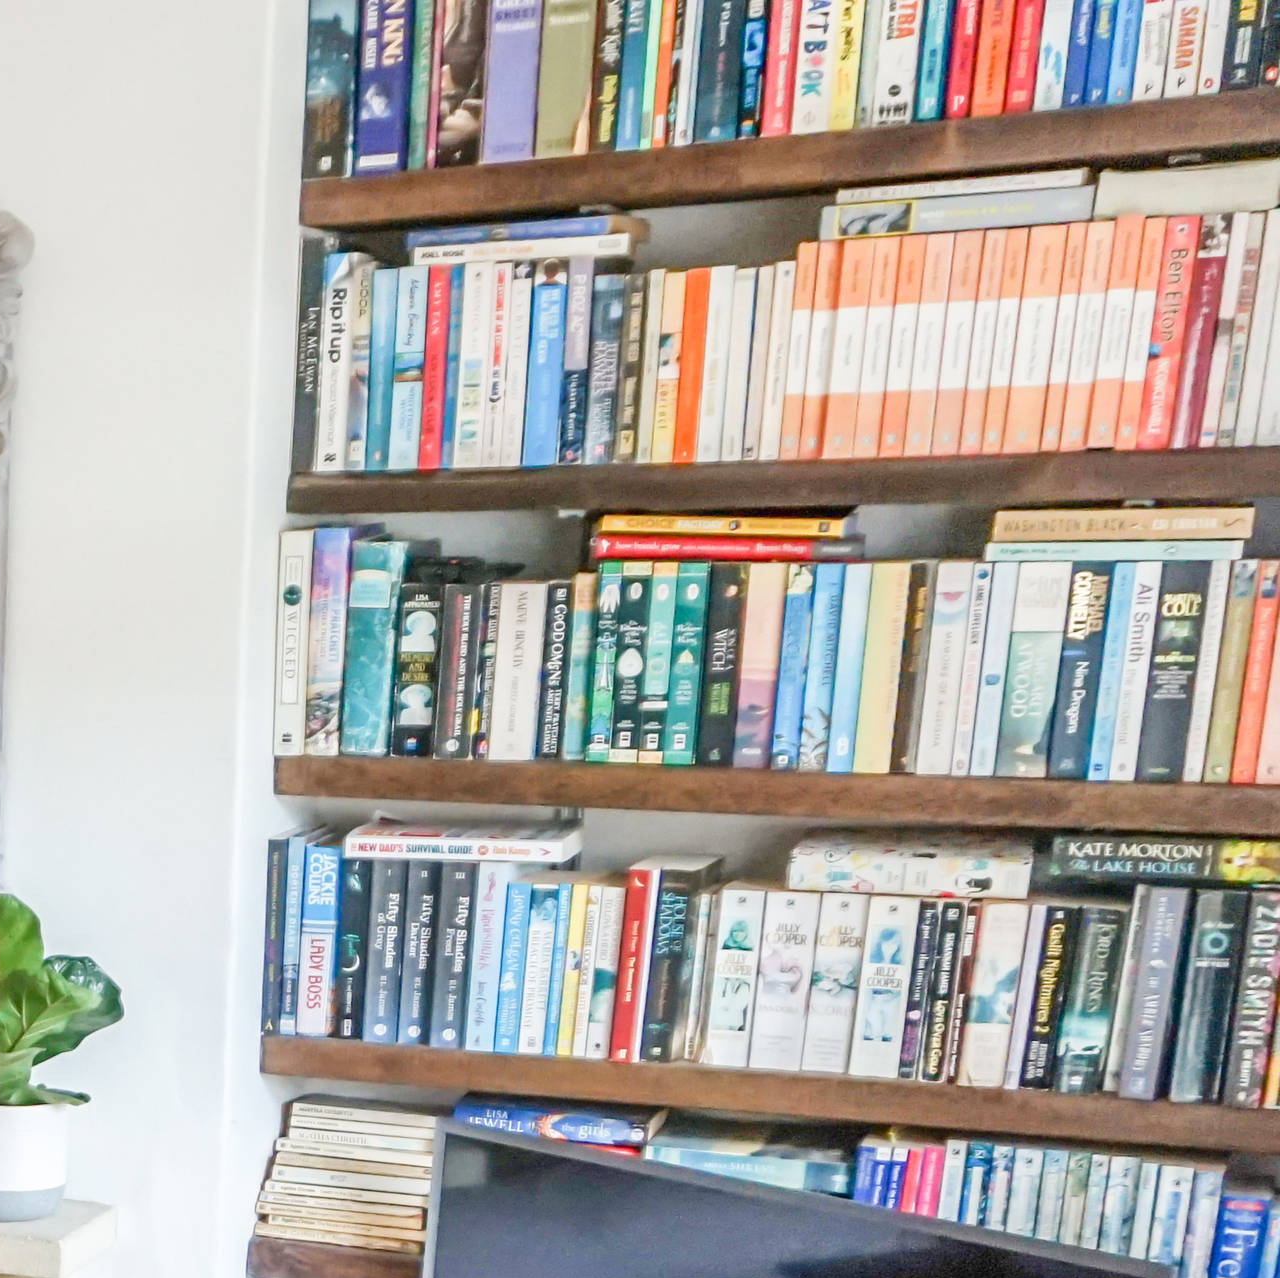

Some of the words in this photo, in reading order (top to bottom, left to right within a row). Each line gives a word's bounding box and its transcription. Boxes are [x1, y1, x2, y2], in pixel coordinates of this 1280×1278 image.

[383, 19, 404, 67] KING
[1174, 7, 1200, 69] SAHARA
[1169, 248, 1189, 285] Ben
[330, 288, 347, 320] Rip
[433, 280, 443, 306] AMY
[308, 307, 321, 329] IAN
[331, 323, 344, 334] it
[431, 311, 441, 335] TAN
[1159, 291, 1183, 343] Elton
[328, 338, 342, 363] up
[1147, 357, 1170, 435] INCONCEIVABLE
[1003, 520, 1081, 533] WASHINGTON
[1086, 519, 1126, 532] BLACK
[462, 595, 472, 611] THE
[515, 590, 529, 626] MAEVE
[974, 584, 985, 607] JAMES
[1067, 570, 1092, 641] CONNELLY
[1090, 575, 1108, 634] MICHAEL
[1136, 583, 1153, 605] Ali
[1162, 601, 1201, 616] COLE
[460, 612, 470, 632] HOLY
[970, 608, 983, 645] LOVELOCK
[1128, 611, 1149, 663] Smith
[284, 611, 298, 680] WICKED
[512, 630, 525, 670] BINCHY
[711, 628, 728, 672] WITCH
[821, 633, 836, 687] MITCHELL
[458, 658, 467, 674] AND
[1010, 642, 1032, 718] ATWOOD
[1075, 661, 1090, 687] Nine
[457, 676, 465, 691] THE
[455, 693, 464, 712] HOLY
[1065, 689, 1086, 734] Dragons
[453, 714, 463, 737] GRAIL
[542, 724, 551, 753] GAIMAN
[549, 712, 561, 753] PRATCHETT
[358, 843, 378, 852] NEW
[379, 843, 404, 853] DAD'S
[405, 844, 446, 854] SURVIVAL
[448, 844, 474, 855] GUIDE
[1068, 841, 1111, 857] KATE
[1114, 842, 1204, 858] MORTON
[307, 853, 322, 905] COLLINS
[320, 854, 337, 905] JACKIE
[1093, 861, 1134, 872] LAKE
[1138, 862, 1196, 875] HOUSE
[376, 913, 385, 923] of
[385, 893, 400, 923] Fifty
[419, 894, 434, 926] Fifty
[455, 896, 470, 928] Fifty
[655, 892, 675, 955] SHADOWS
[671, 895, 688, 938] HOUSE
[287, 919, 297, 949] DIARY
[373, 925, 385, 950] Grey
[408, 922, 420, 958] Darker
[443, 928, 455, 956] Freed
[776, 923, 801, 933] JILLY
[1046, 923, 1065, 956] Gaslit
[1094, 924, 1118, 959] LORD
[1247, 905, 1279, 969] ZADIE
[309, 938, 325, 972] LADY
[384, 926, 397, 969] Shades
[418, 927, 432, 970] Shades
[453, 929, 467, 973] Shades
[672, 940, 682, 952] OF
[940, 932, 955, 971] SUSANNAH
[866, 977, 903, 989] COOPER
[874, 967, 898, 977] JILLY
[939, 971, 953, 994] JAMES
[306, 975, 322, 1009] BOSS
[1036, 959, 1061, 1022] Nightmares
[1086, 970, 1108, 1013] RINGS
[934, 999, 949, 1022] LOVE
[1141, 994, 1161, 1026] AMBER
[1237, 974, 1270, 1045] SMITH
[932, 1023, 945, 1048] OVER
[1035, 1024, 1050, 1033] 2
[928, 1049, 942, 1075] GOLD
[1037, 1043, 1048, 1068] EDITED
[1133, 1028, 1154, 1071] SHADOWS
[1244, 1049, 1254, 1060] ON
[1239, 1061, 1251, 1088] BEAUTY
[487, 1110, 508, 1119] LISA
[578, 1123, 611, 1138] girls
